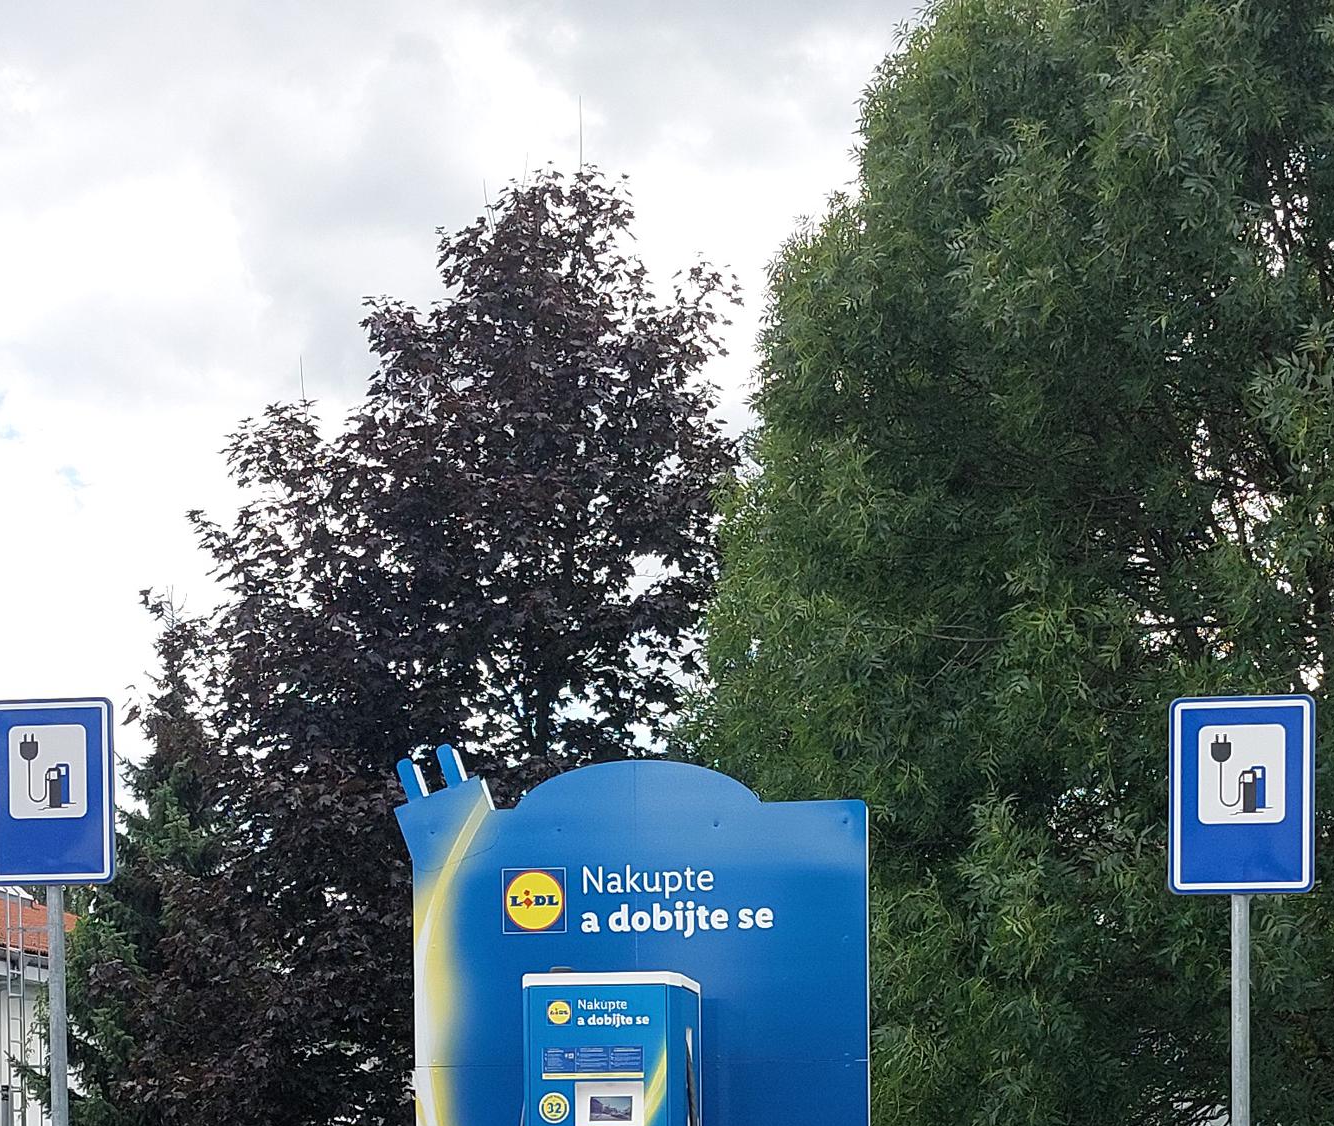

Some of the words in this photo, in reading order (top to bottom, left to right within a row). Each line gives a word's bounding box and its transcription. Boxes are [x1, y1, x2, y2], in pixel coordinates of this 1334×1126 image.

[582, 864, 714, 899] Nakupte
[581, 911, 600, 933] a
[608, 901, 729, 938] dobijte
[738, 908, 774, 929] se
[577, 998, 627, 1012] Nakupte
[577, 1017, 585, 1025] a
[587, 1014, 633, 1028] dobijte
[636, 1015, 650, 1025] se
